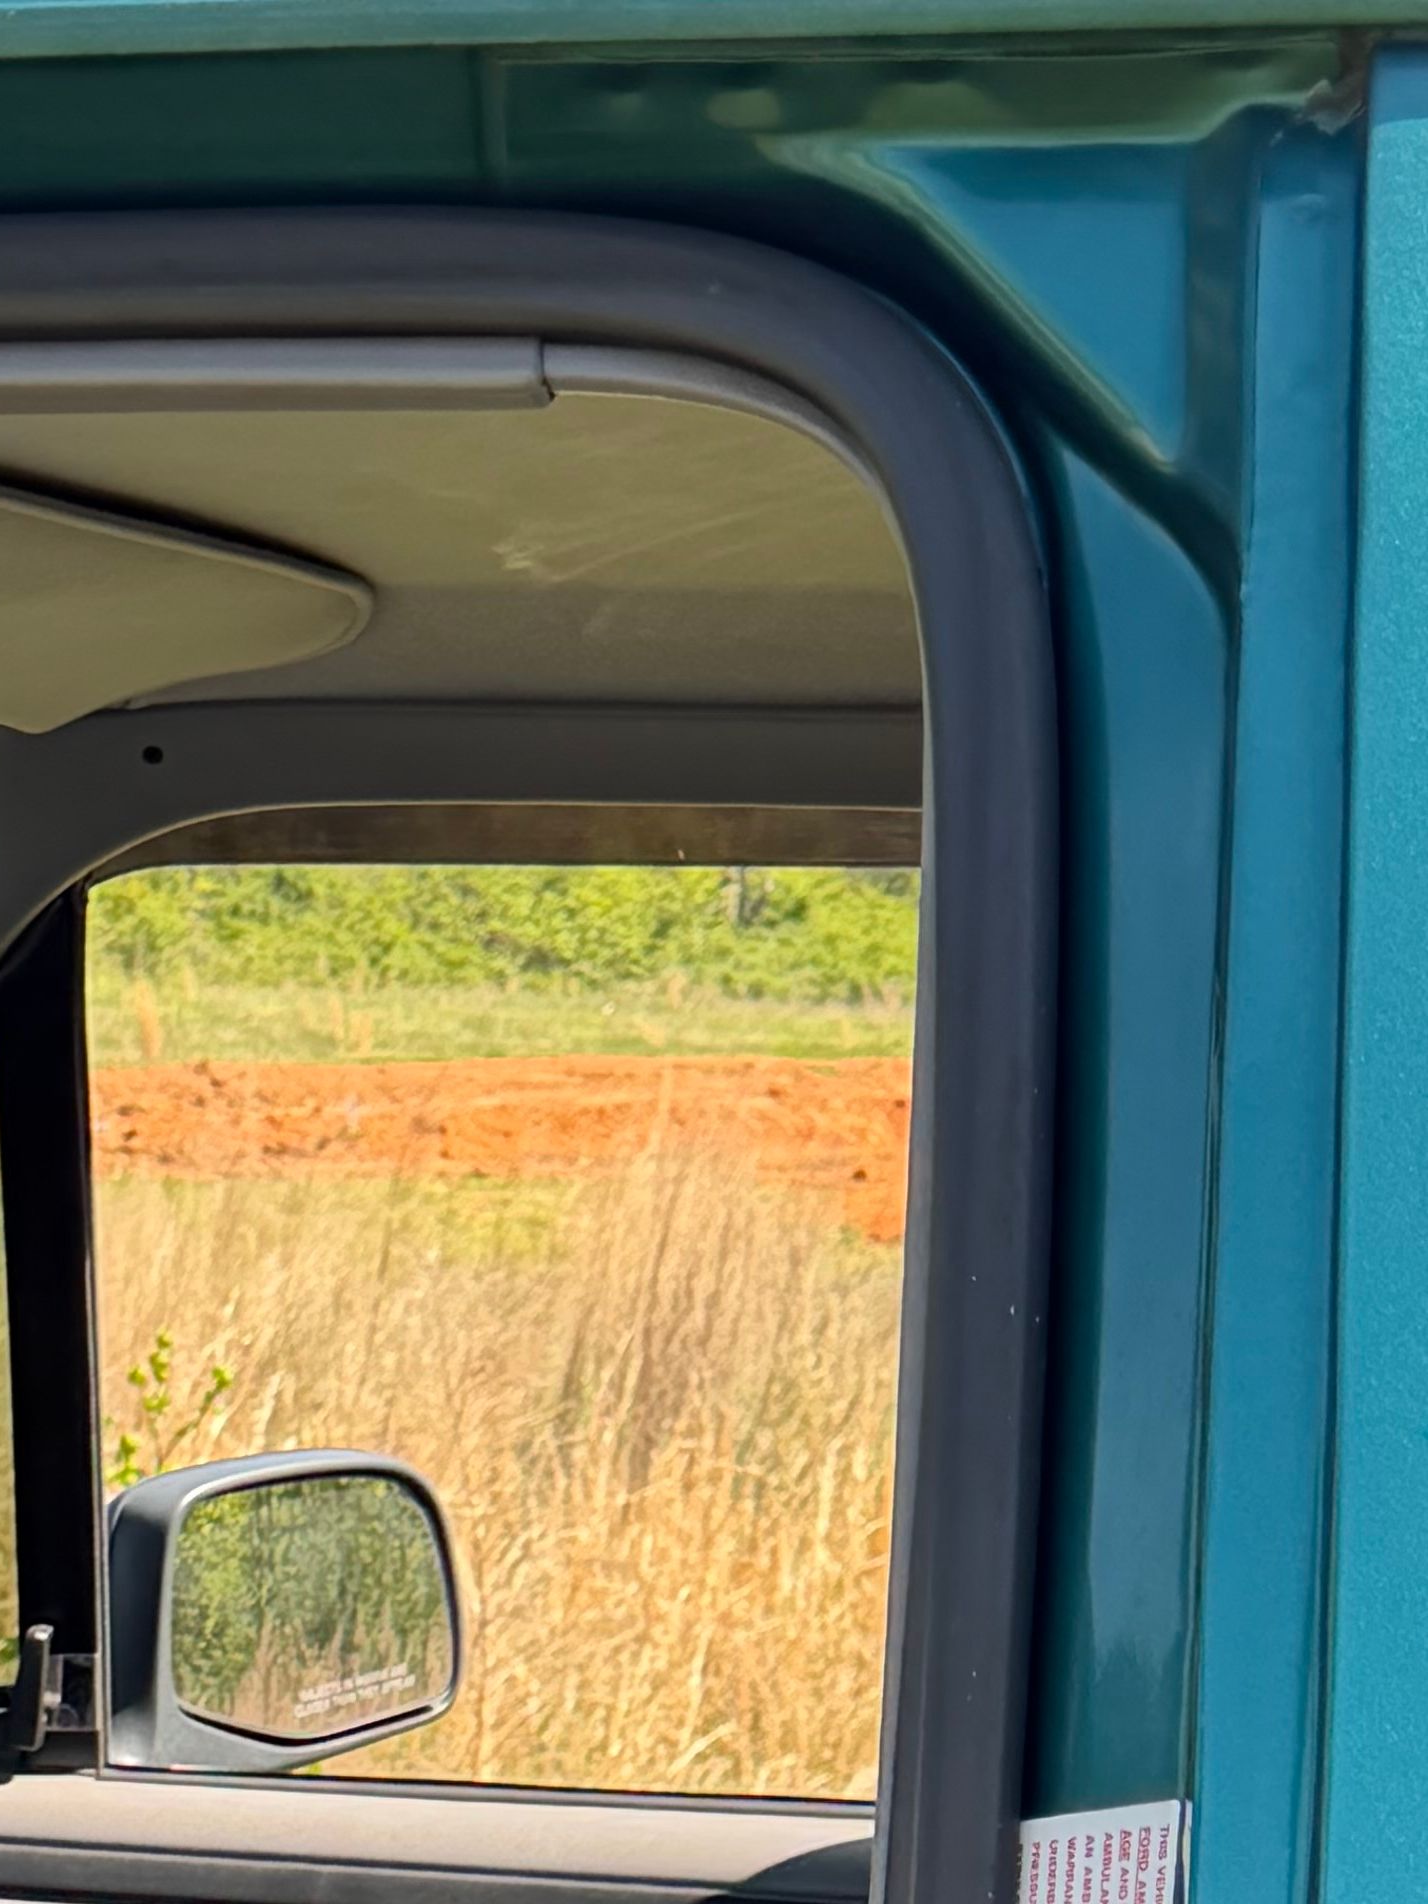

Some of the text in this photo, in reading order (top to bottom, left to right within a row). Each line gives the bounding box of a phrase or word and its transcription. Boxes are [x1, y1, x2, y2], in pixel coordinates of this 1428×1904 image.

[1085, 1835, 1095, 1858] AN
[1121, 1830, 1132, 1862] AGE
[1139, 1826, 1151, 1871] FORD
[1158, 1824, 1170, 1860] THIS
[1119, 1867, 1129, 1900] AND
